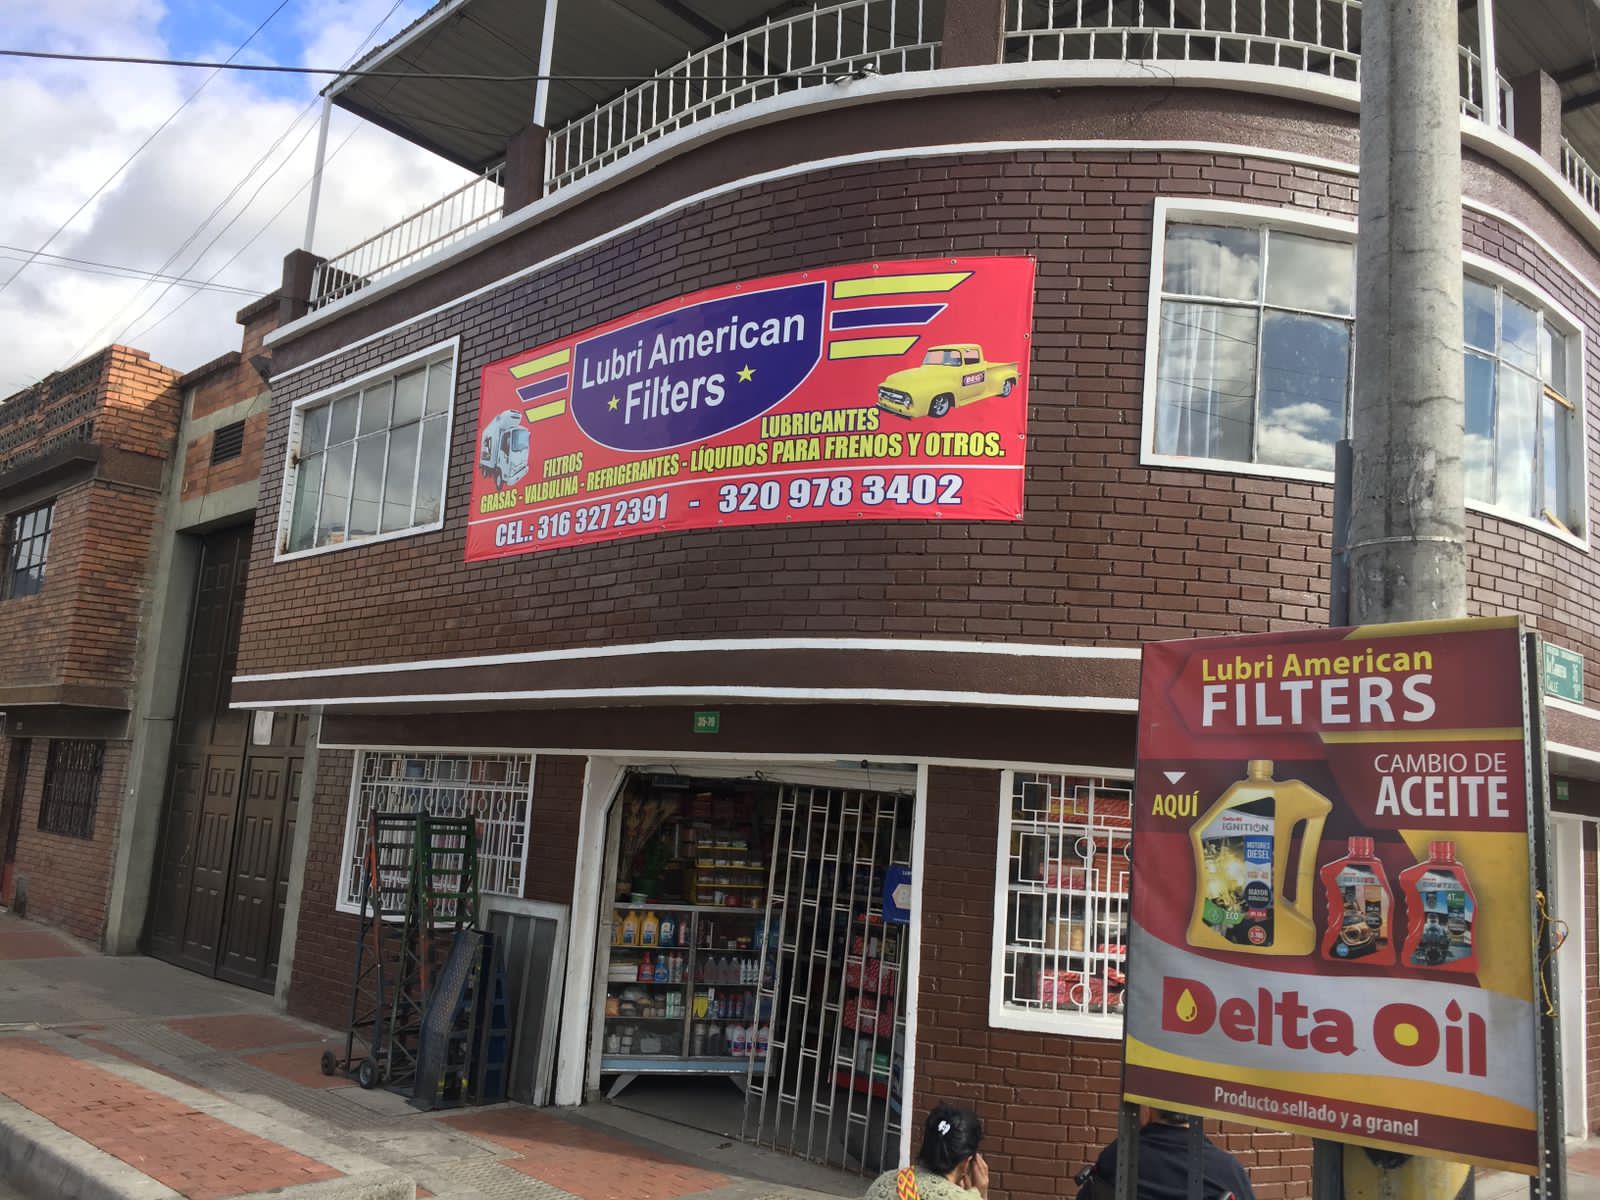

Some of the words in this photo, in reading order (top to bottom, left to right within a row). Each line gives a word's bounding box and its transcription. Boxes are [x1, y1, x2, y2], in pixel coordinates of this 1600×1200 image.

[582, 340, 643, 390] Lubri
[648, 313, 805, 371] American
[624, 373, 726, 425] Filters
[761, 407, 880, 439] LUBRICANTES
[480, 489, 517, 513] GRASAS
[524, 476, 579, 504] VALBULINA
[586, 453, 680, 492] REFRIGERANTES
[690, 442, 768, 472] LÍQUIDOS
[772, 437, 821, 464] PARA
[824, 433, 902, 460] FRENOS
[907, 432, 922, 457] Y
[925, 431, 1006, 457] OTROS.
[543, 452, 584, 478] FILTROS
[495, 520, 533, 547] CEL.:
[537, 511, 571, 540] 316
[574, 503, 612, 534] 327
[614, 493, 669, 526] 2391
[718, 480, 781, 514] 320
[788, 476, 853, 508] 978
[861, 473, 964, 506] 3402
[1202, 654, 1274, 682] Lubri
[1282, 647, 1433, 678] American
[1202, 673, 1437, 727] FILTERS
[1374, 752, 1468, 773] CAMBIO
[1475, 752, 1508, 773] DE
[1152, 790, 1200, 819] AQUÍ
[1375, 775, 1510, 818] ACEITE
[1222, 823, 1269, 833] IGNITION
[1247, 849, 1271, 859] DIESEL
[1162, 975, 1358, 1057] Delta
[1373, 998, 1487, 1077] Oil
[1214, 1086, 1279, 1114] Producto
[1282, 1099, 1337, 1124] sellado
[1340, 1111, 1350, 1128] y
[1353, 1115, 1362, 1128] a
[1366, 1119, 1419, 1138] granel
